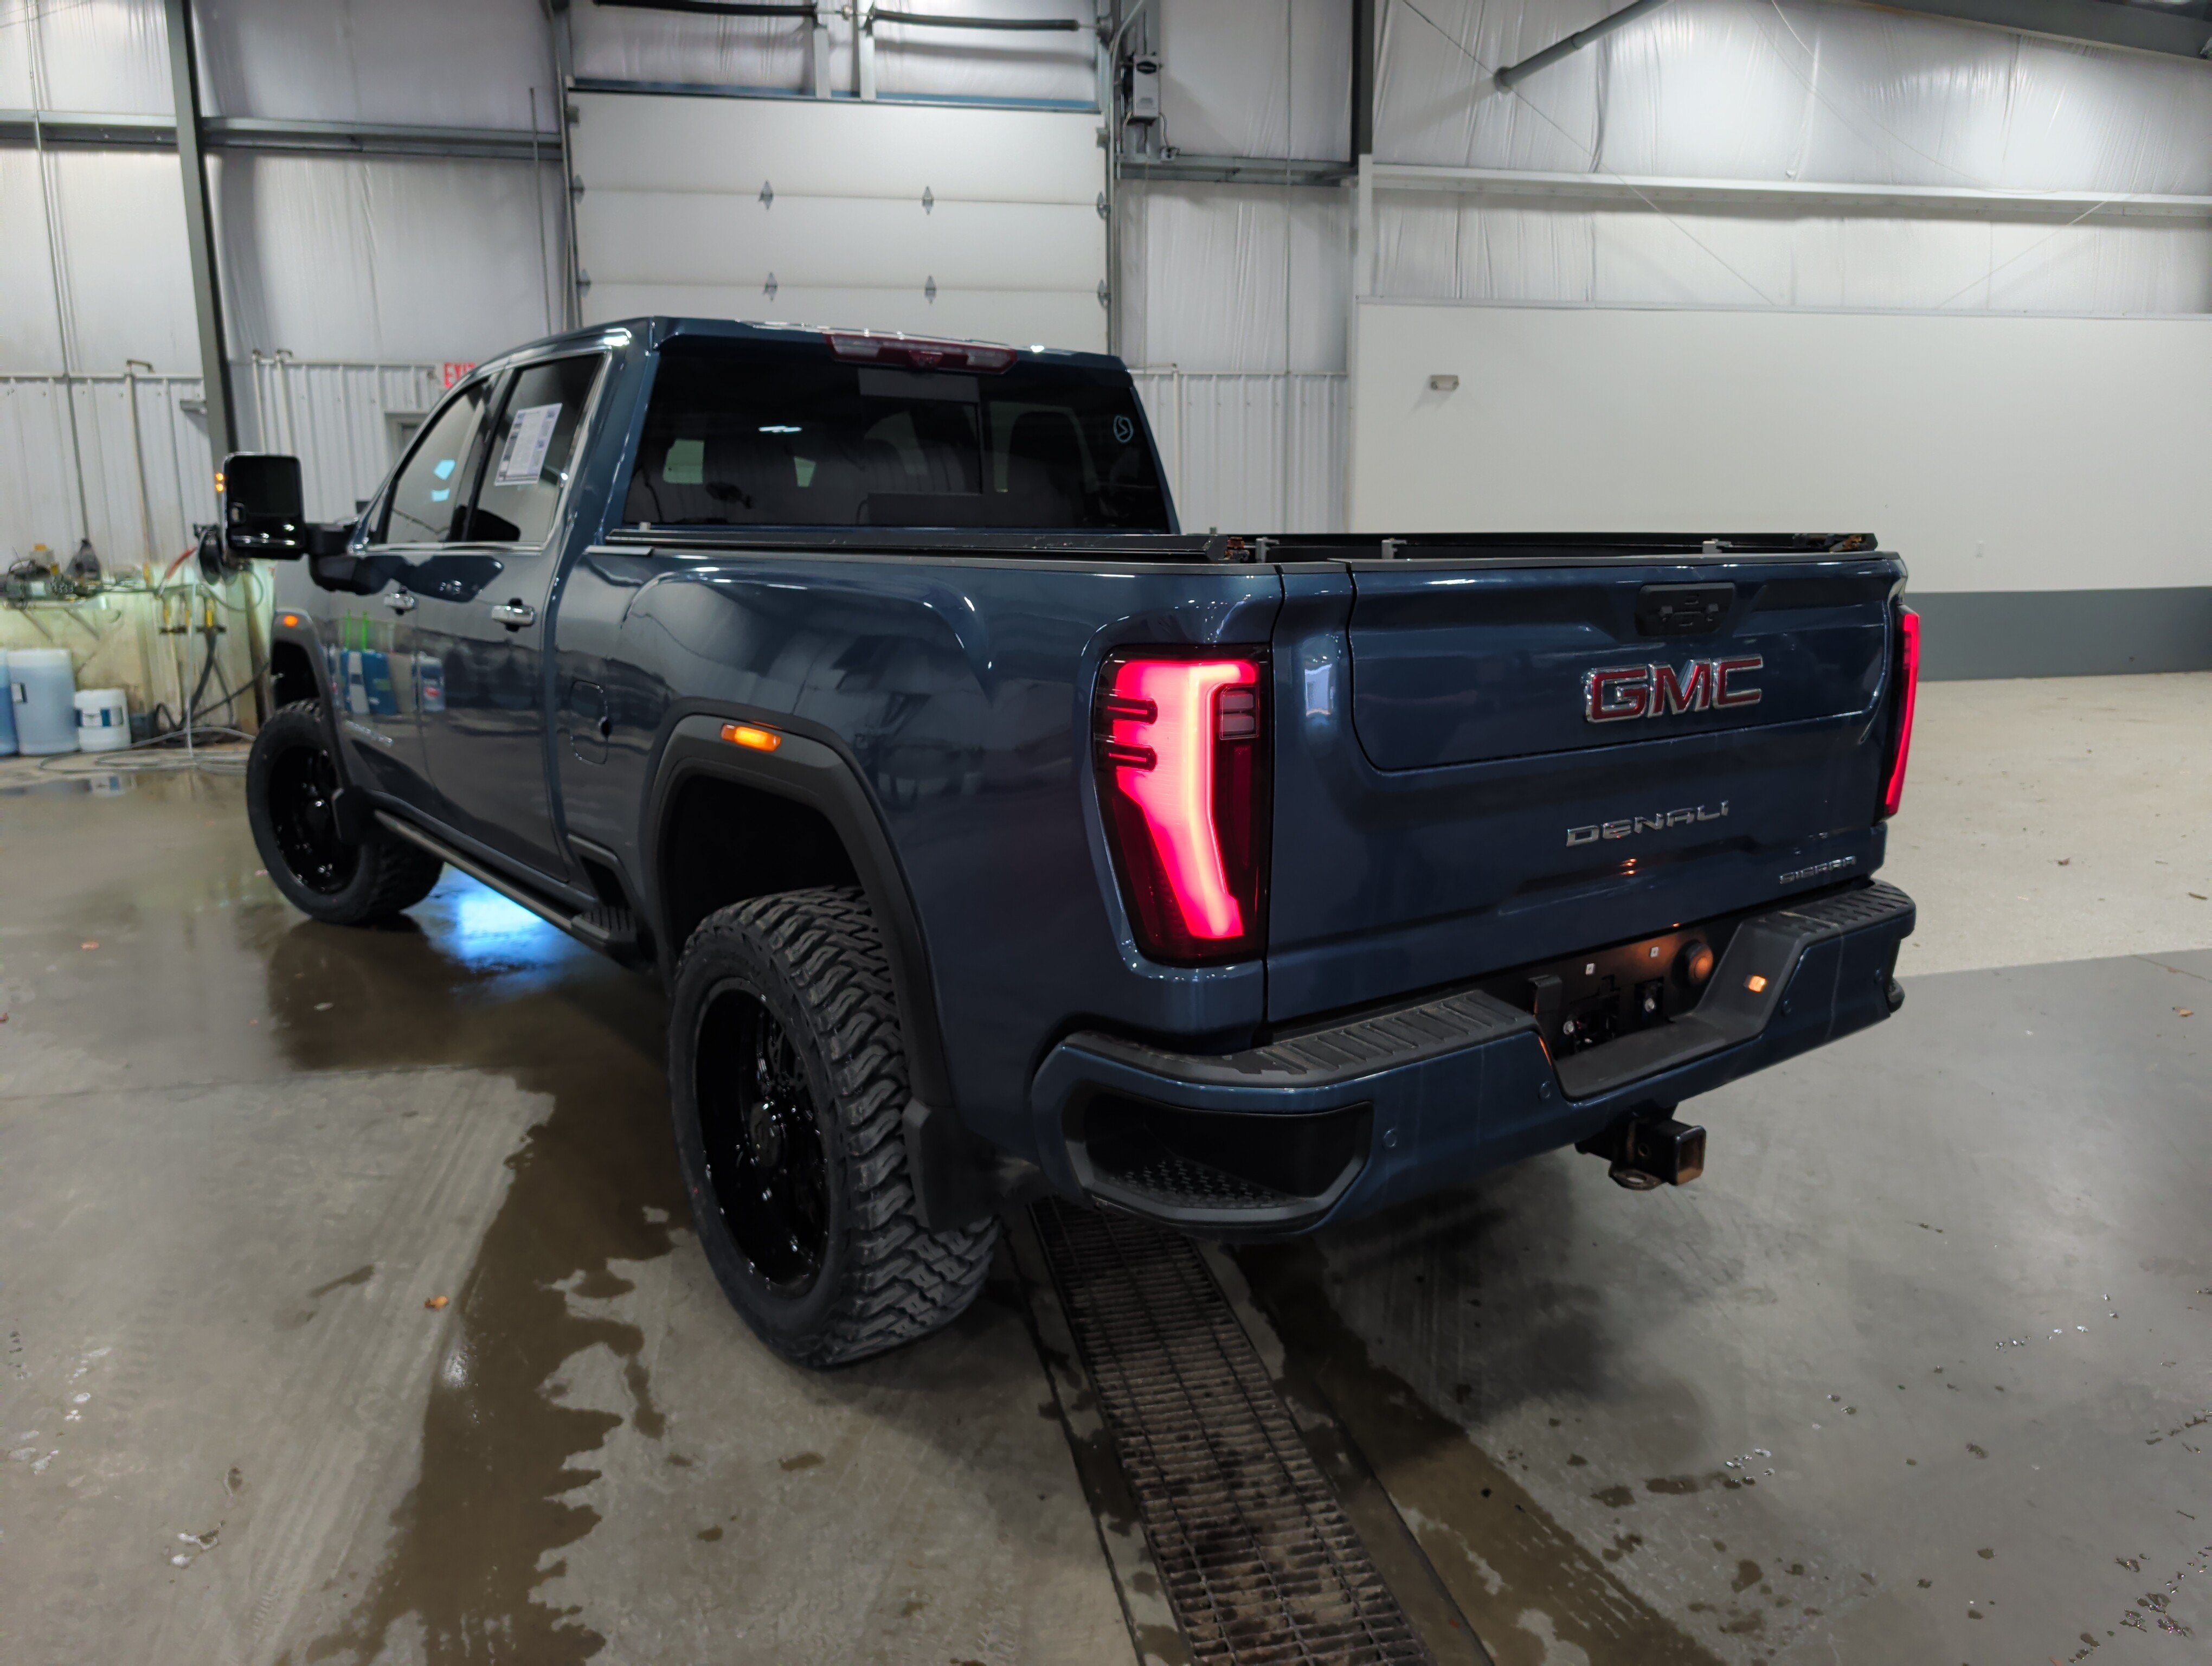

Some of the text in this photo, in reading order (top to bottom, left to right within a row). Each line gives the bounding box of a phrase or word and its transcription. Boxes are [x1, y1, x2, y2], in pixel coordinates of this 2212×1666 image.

[443, 362, 476, 388] EX
[1584, 653, 1763, 723] GMC
[1566, 800, 1729, 847] DENALI
